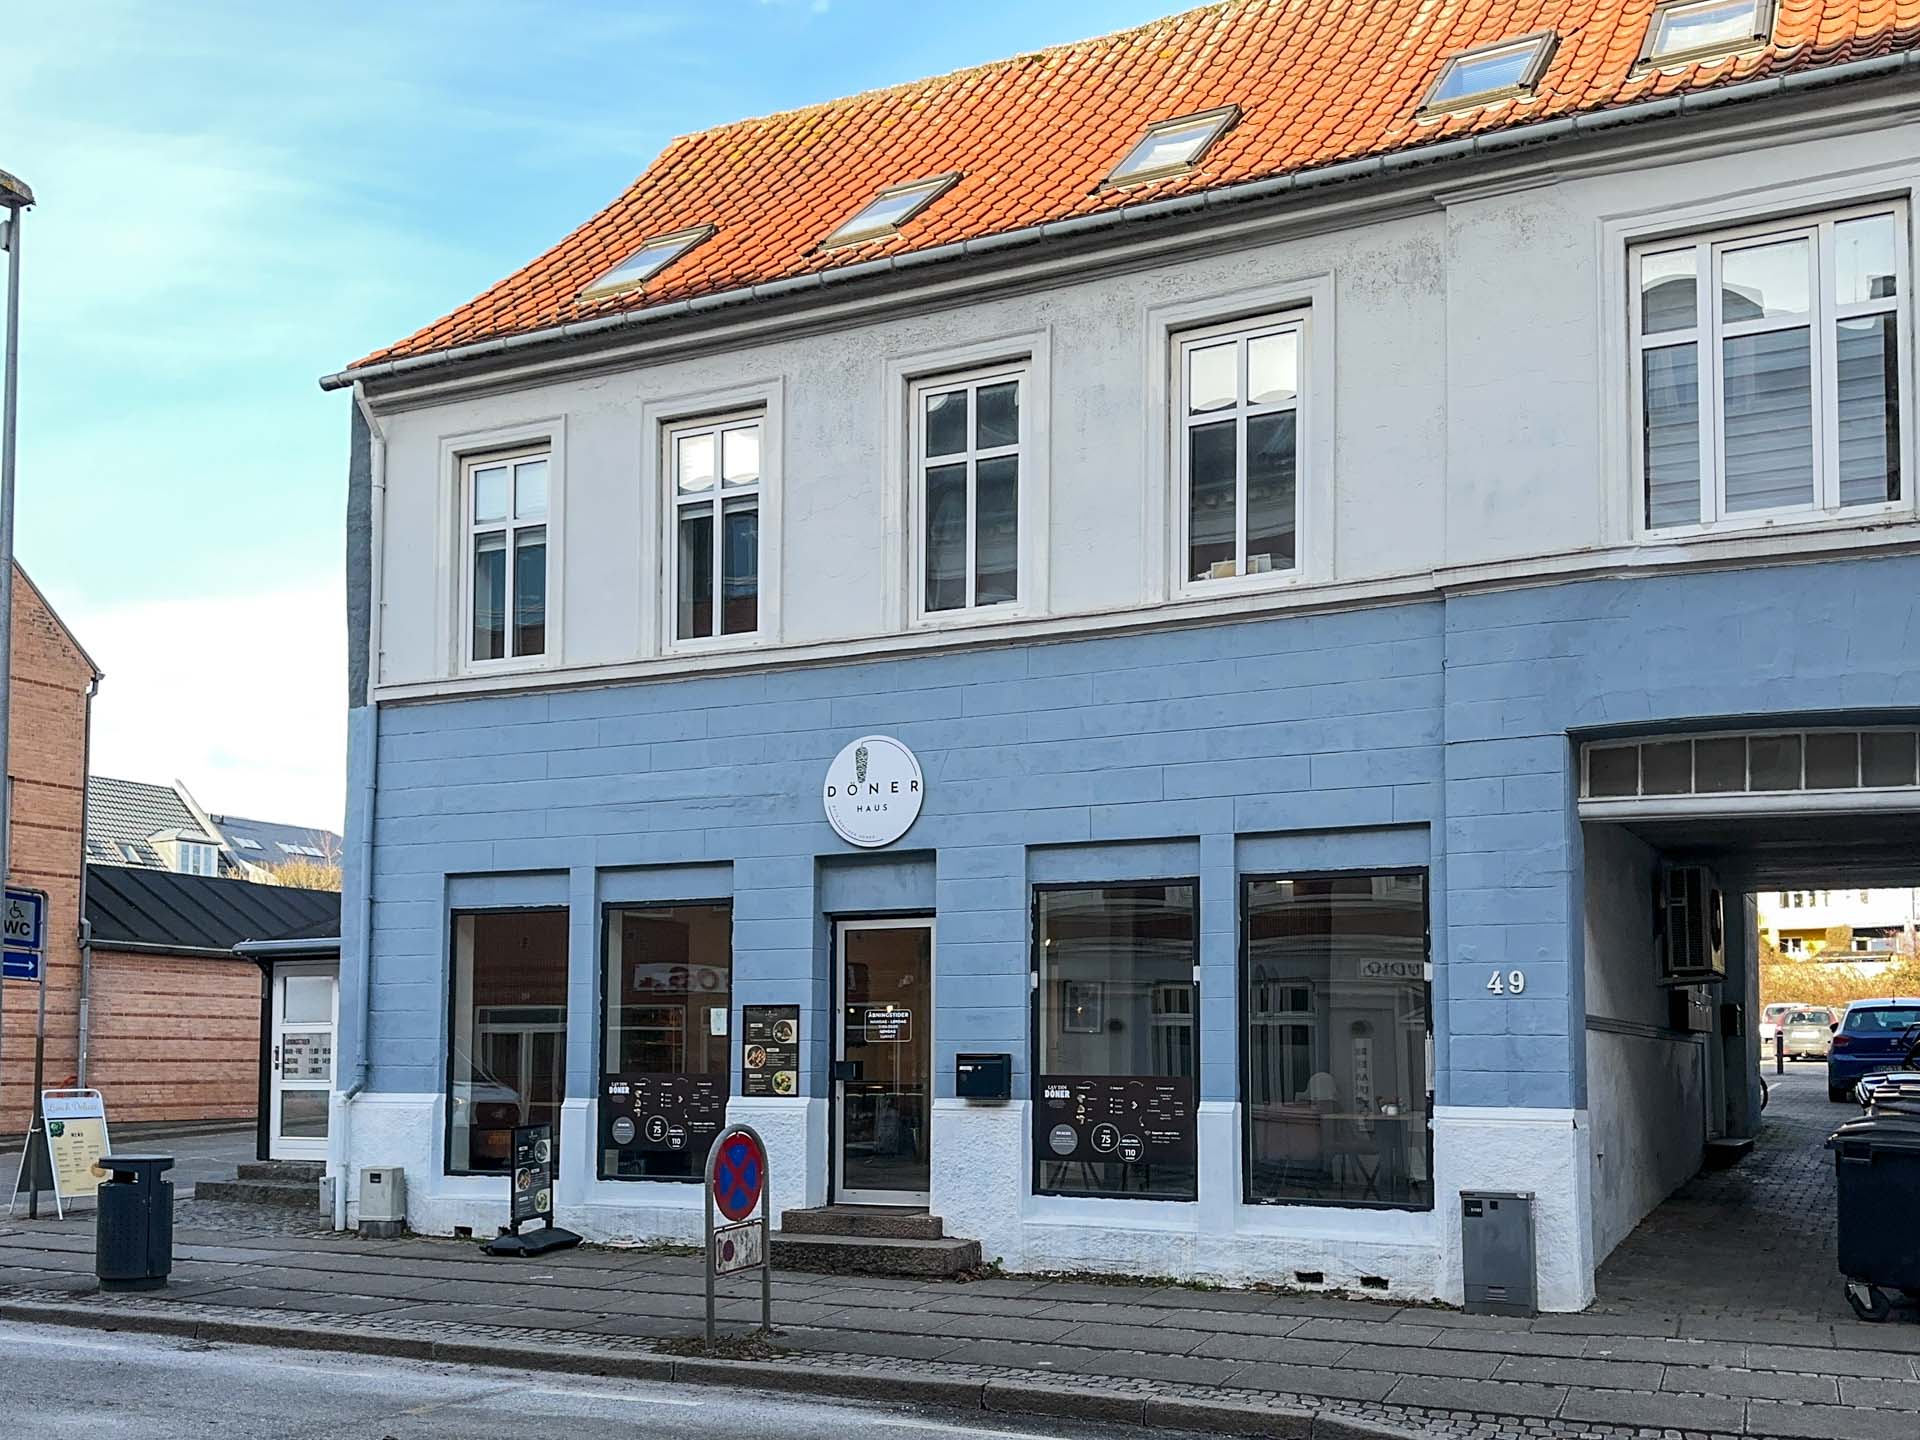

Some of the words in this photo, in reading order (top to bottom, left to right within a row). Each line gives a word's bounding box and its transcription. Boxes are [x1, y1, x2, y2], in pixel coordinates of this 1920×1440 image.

[827, 780, 919, 798] DÖNER
[856, 803, 888, 813] HAUS
[4, 919, 32, 936] WC
[1486, 969, 1525, 995] 49
[653, 1126, 661, 1134] 75
[1101, 1134, 1111, 1144] 75
